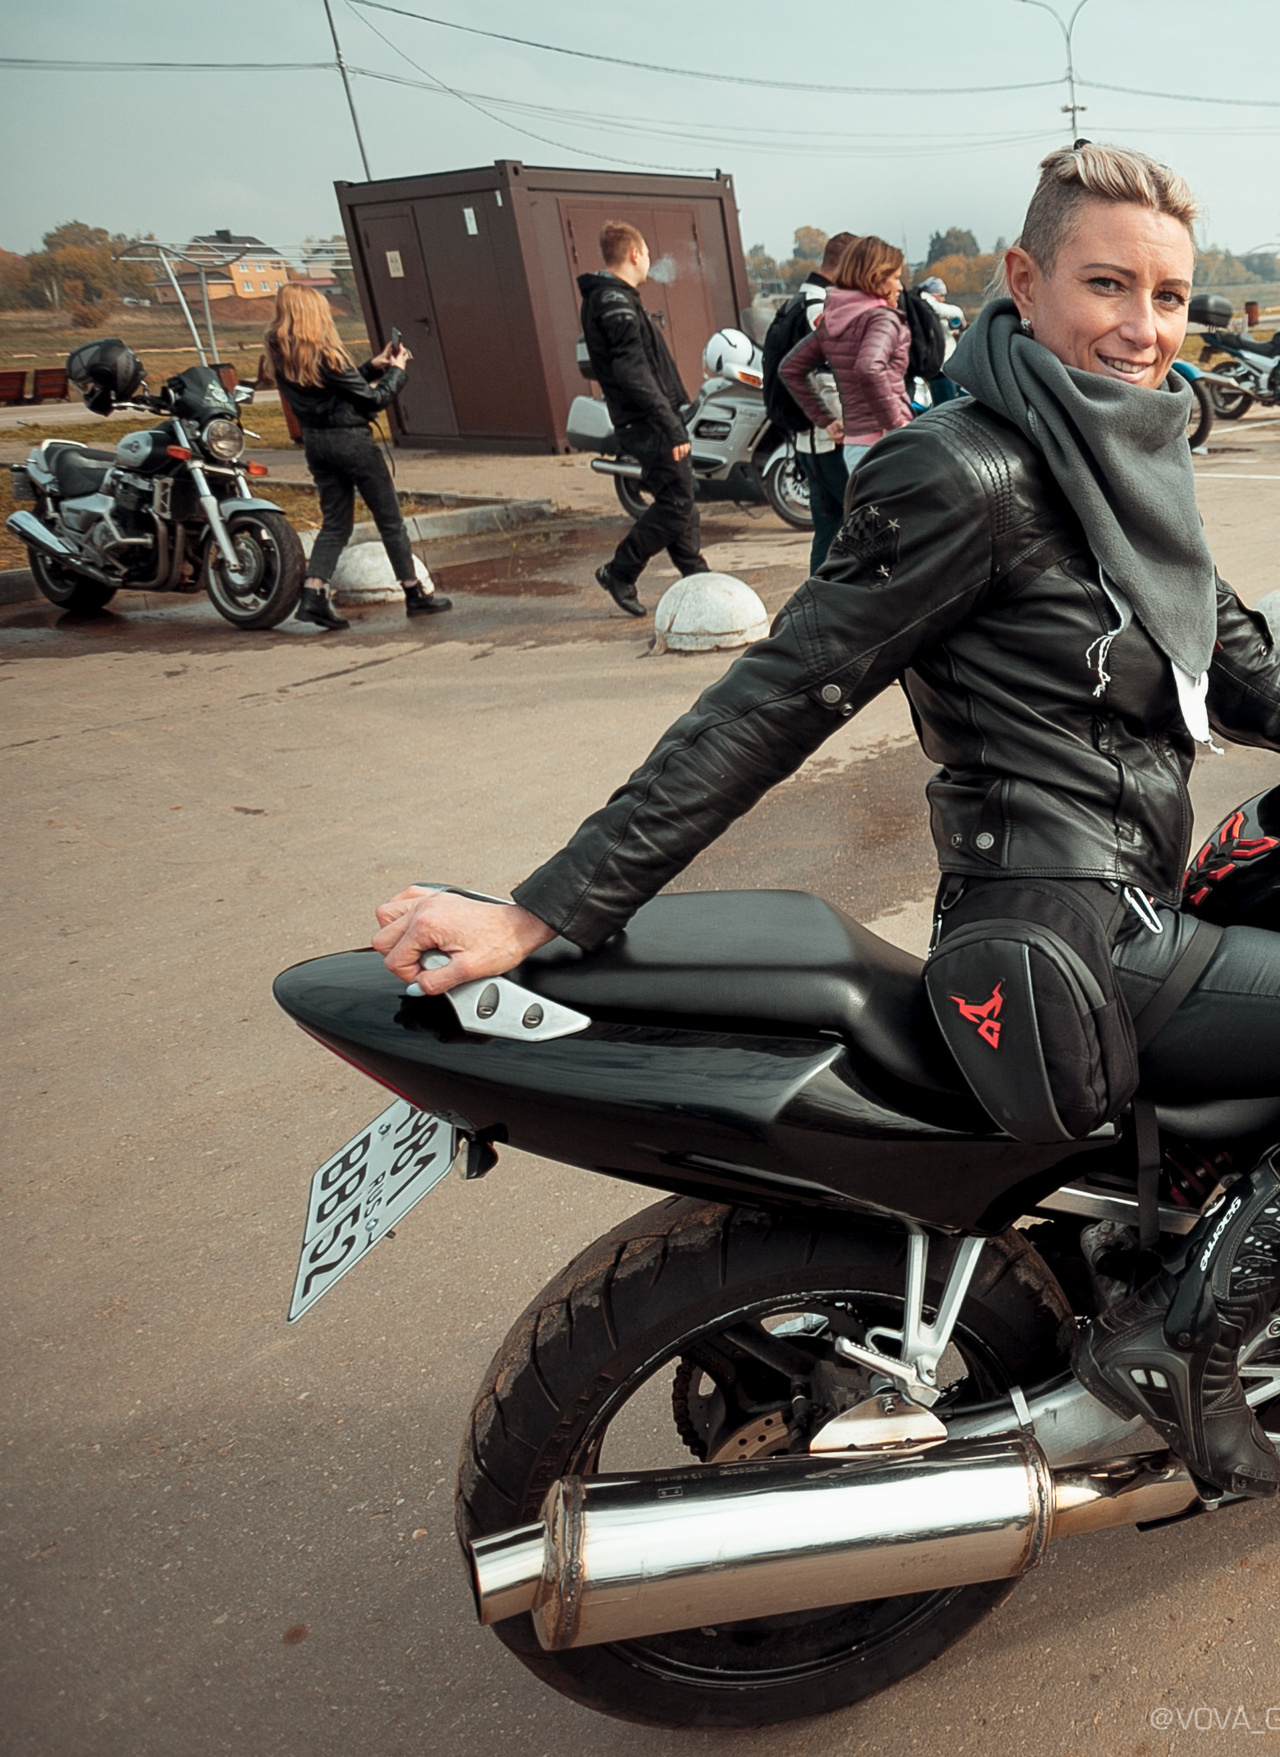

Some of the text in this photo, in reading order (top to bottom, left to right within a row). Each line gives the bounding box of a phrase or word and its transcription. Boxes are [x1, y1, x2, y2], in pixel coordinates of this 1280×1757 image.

[364, 1170, 387, 1219] RUS
[385, 1105, 439, 1208] 981
[1199, 1196, 1242, 1272] gaerne
